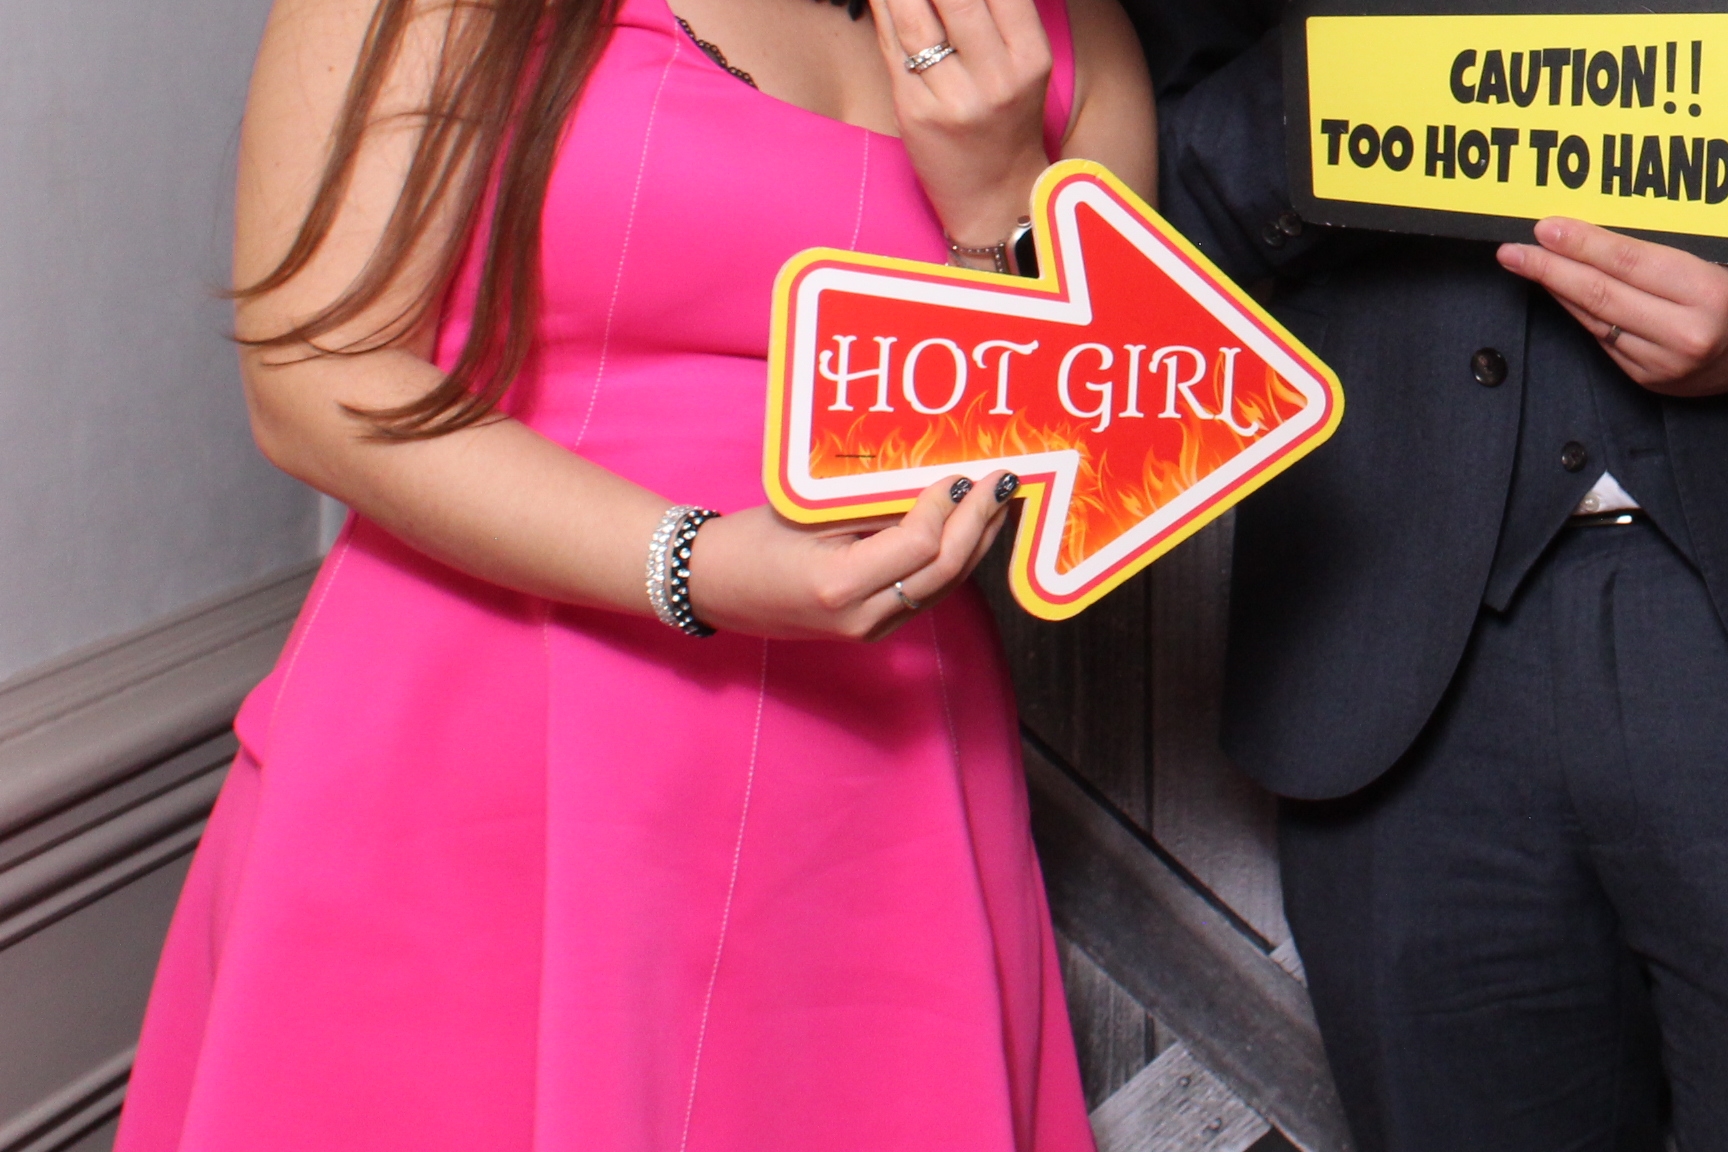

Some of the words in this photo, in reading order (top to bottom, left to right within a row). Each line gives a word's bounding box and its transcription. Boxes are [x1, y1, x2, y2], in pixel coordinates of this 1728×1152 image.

[1449, 40, 1704, 118] CAUTION!!
[1320, 118, 1414, 173] TOO
[1424, 124, 1519, 183] HOT
[1528, 128, 1591, 190] TO
[818, 334, 1039, 416] HOT
[1056, 342, 1264, 438] GIRL
